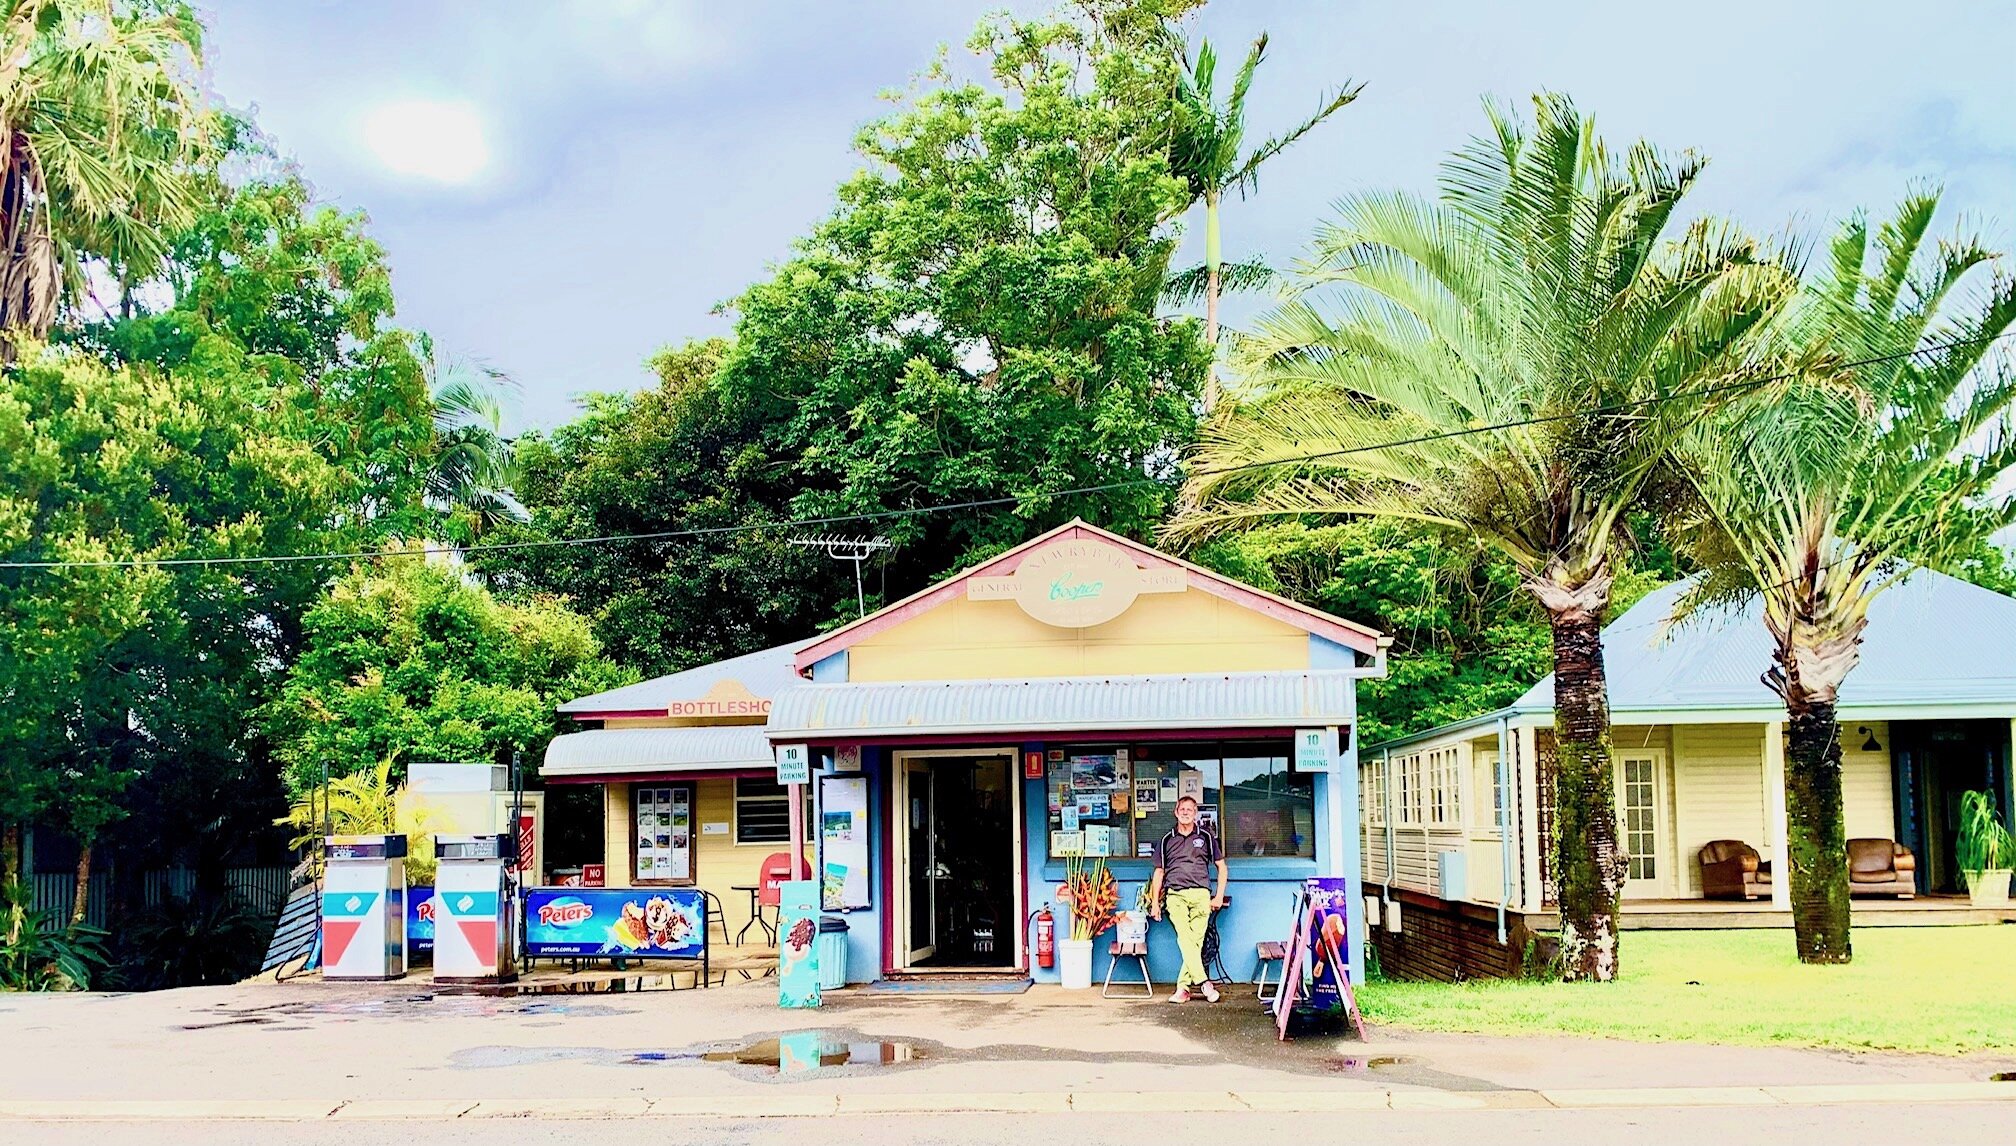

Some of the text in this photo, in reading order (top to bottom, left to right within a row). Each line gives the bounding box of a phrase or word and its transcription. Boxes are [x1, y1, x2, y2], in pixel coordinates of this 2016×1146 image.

[1306, 734, 1319, 746] 10
[786, 749, 797, 760] 10
[1301, 749, 1325, 757] MINUTE
[1298, 760, 1328, 768] PARKING
[780, 772, 806, 780] PARKING
[589, 869, 601, 878] NO
[539, 904, 593, 925] Peters
